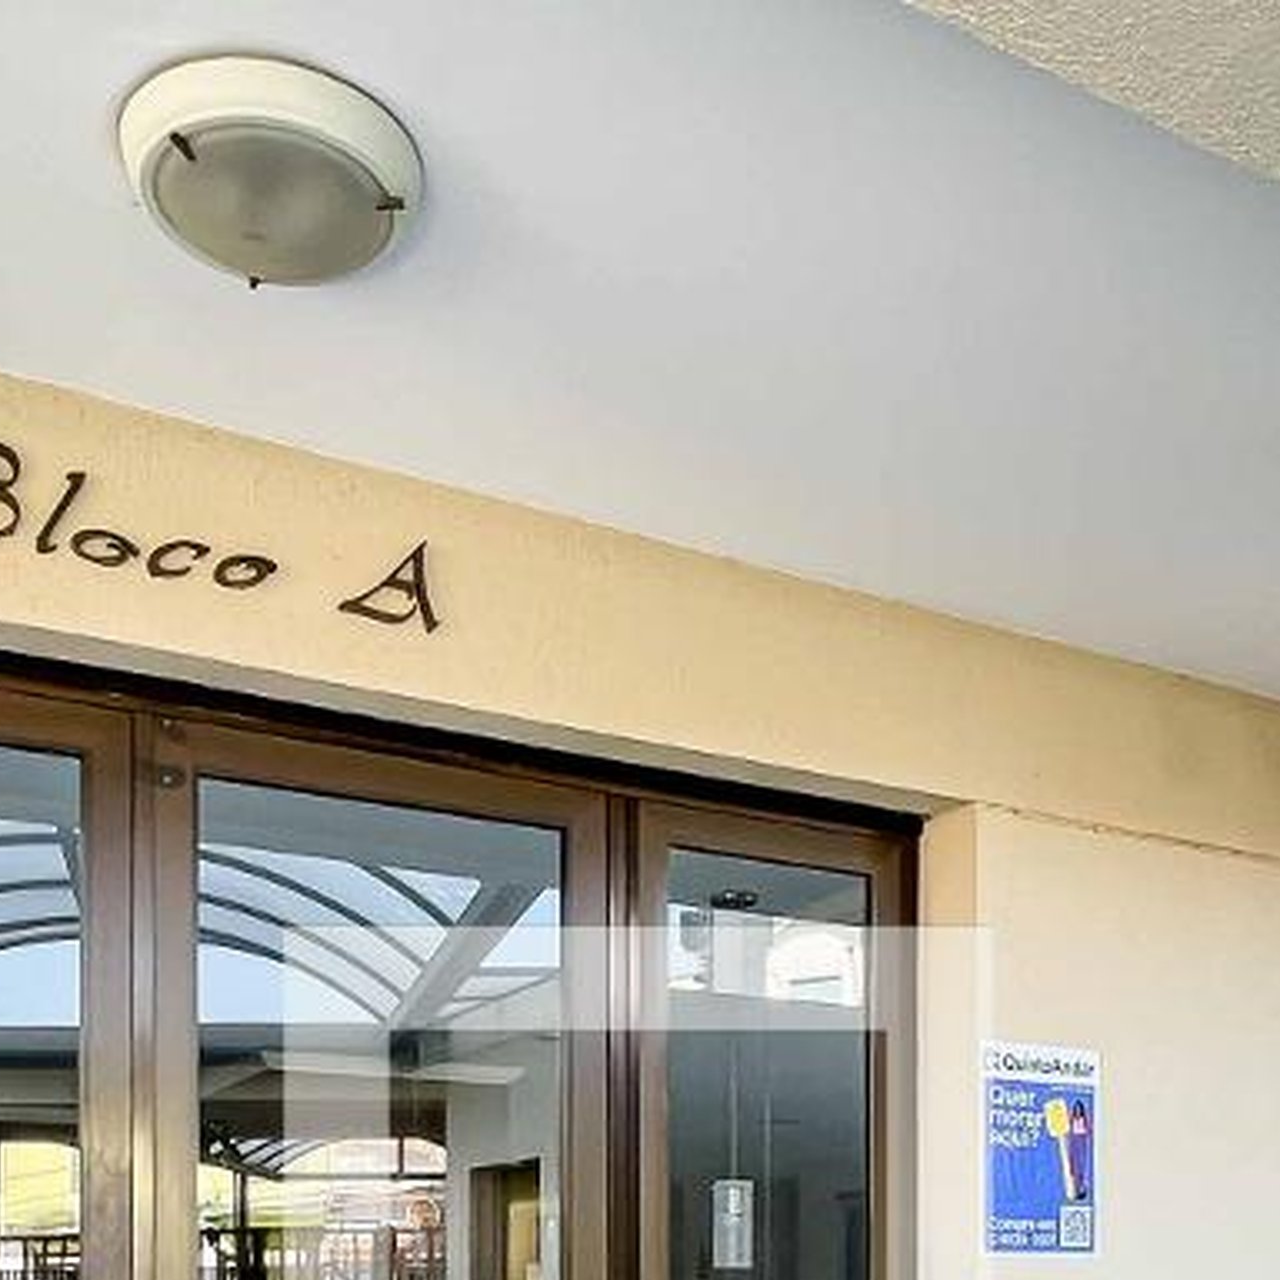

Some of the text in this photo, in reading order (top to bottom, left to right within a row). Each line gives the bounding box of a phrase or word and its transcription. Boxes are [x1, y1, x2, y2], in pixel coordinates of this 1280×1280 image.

[337, 538, 440, 635] A
[1002, 1052, 1095, 1077] QuintoAndar
[988, 1086, 1036, 1106] Quer
